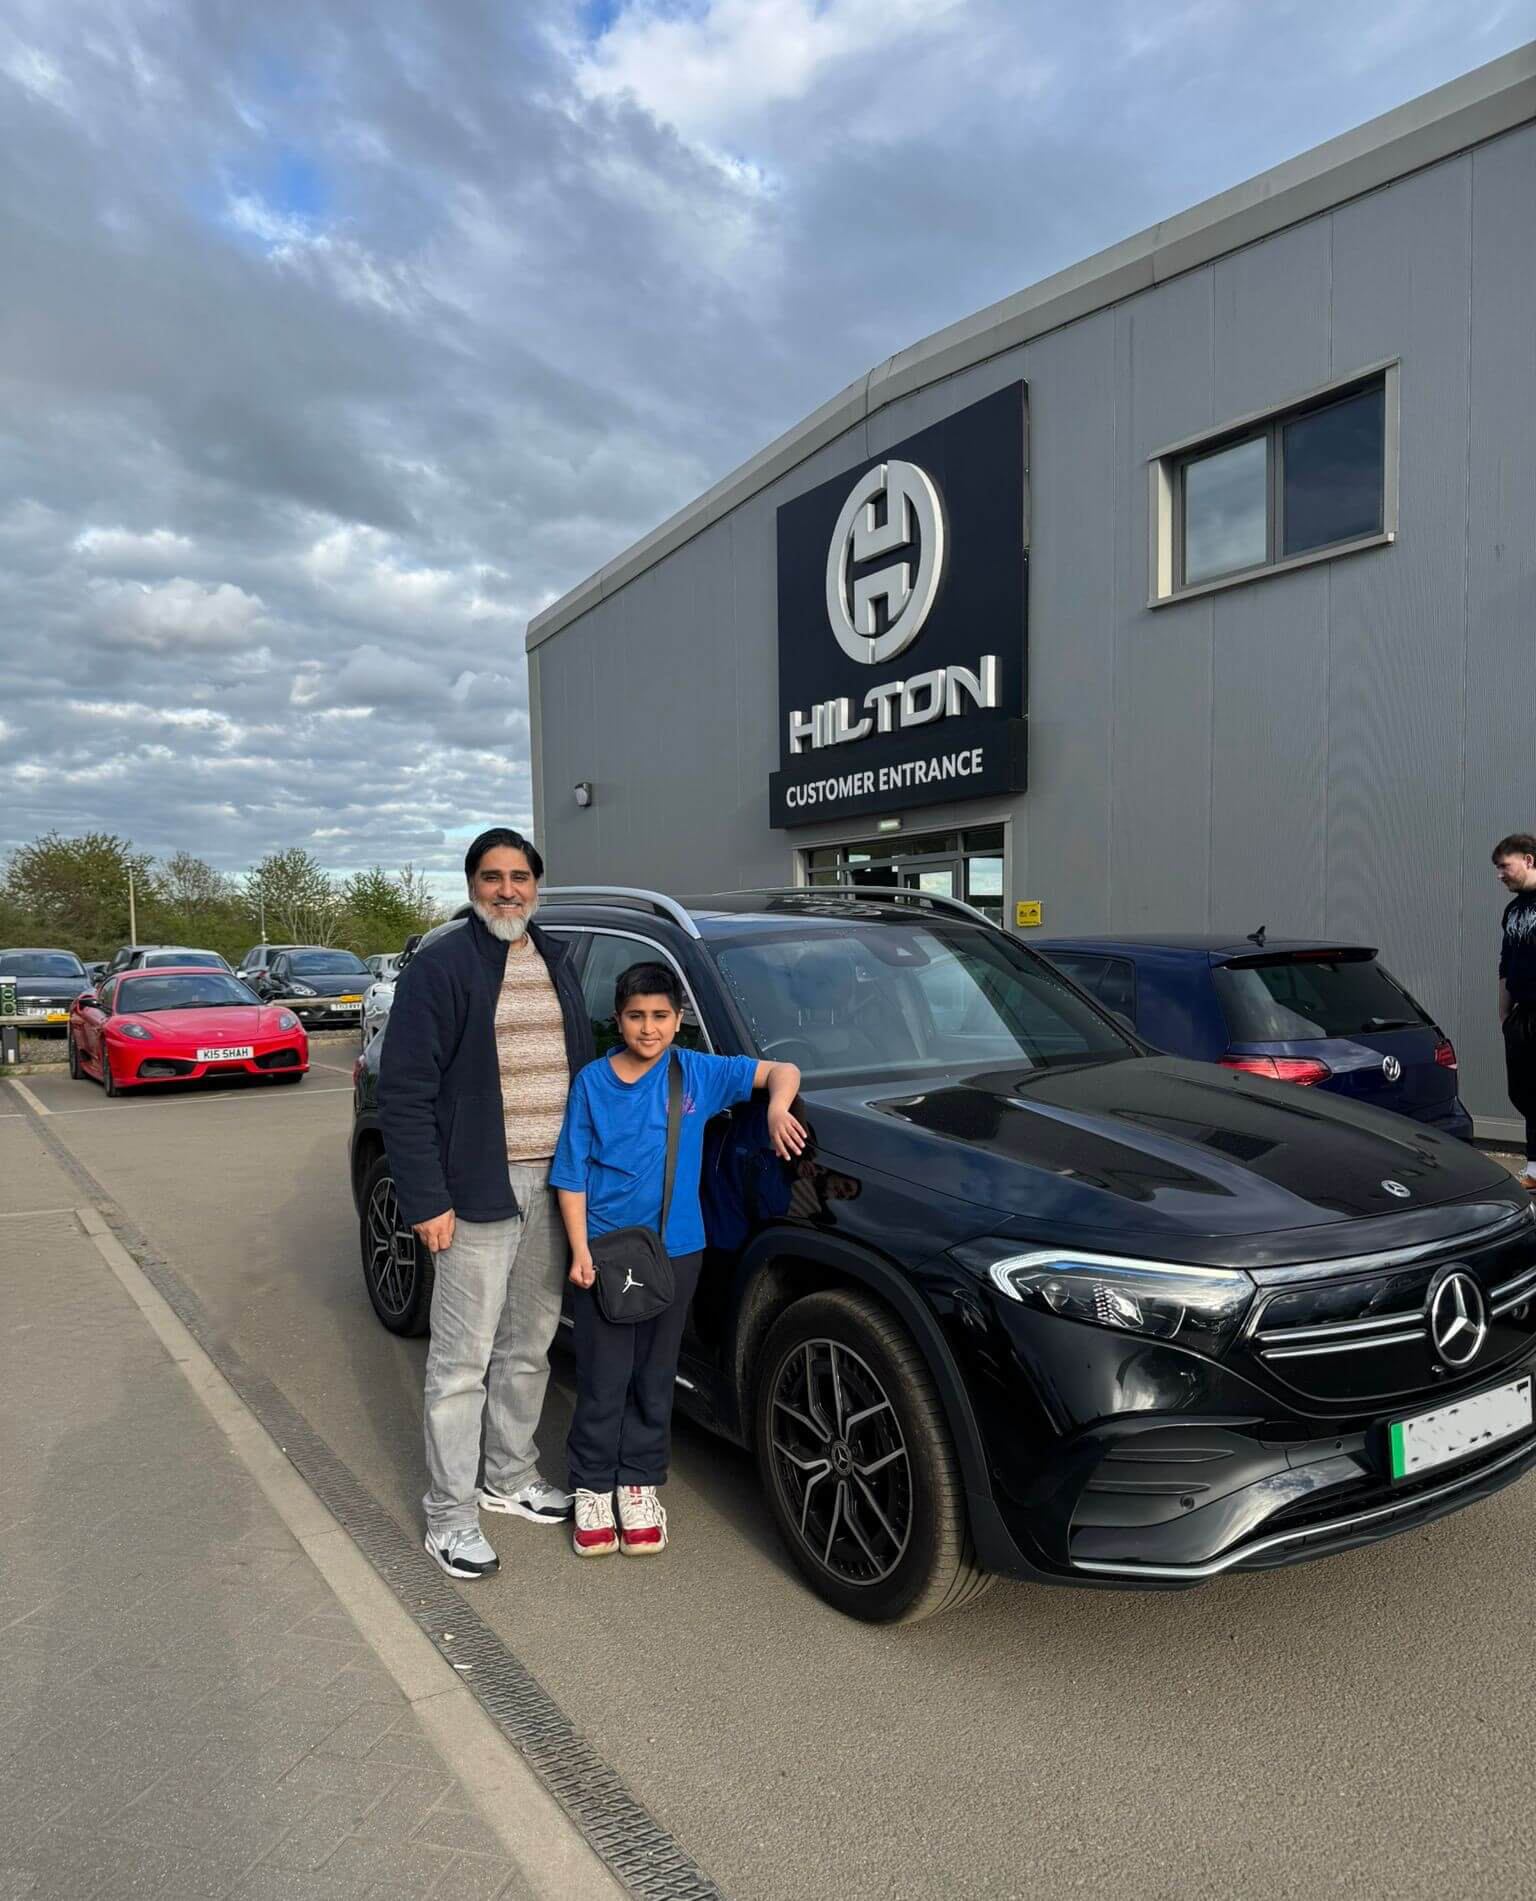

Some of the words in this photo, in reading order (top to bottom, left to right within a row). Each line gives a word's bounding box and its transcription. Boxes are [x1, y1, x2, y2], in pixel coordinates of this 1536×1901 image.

[789, 655, 997, 754] HILTON
[786, 770, 875, 808] CUSTOMER
[879, 748, 984, 791] ENTRANCE
[223, 1047, 249, 1059] SHAH
